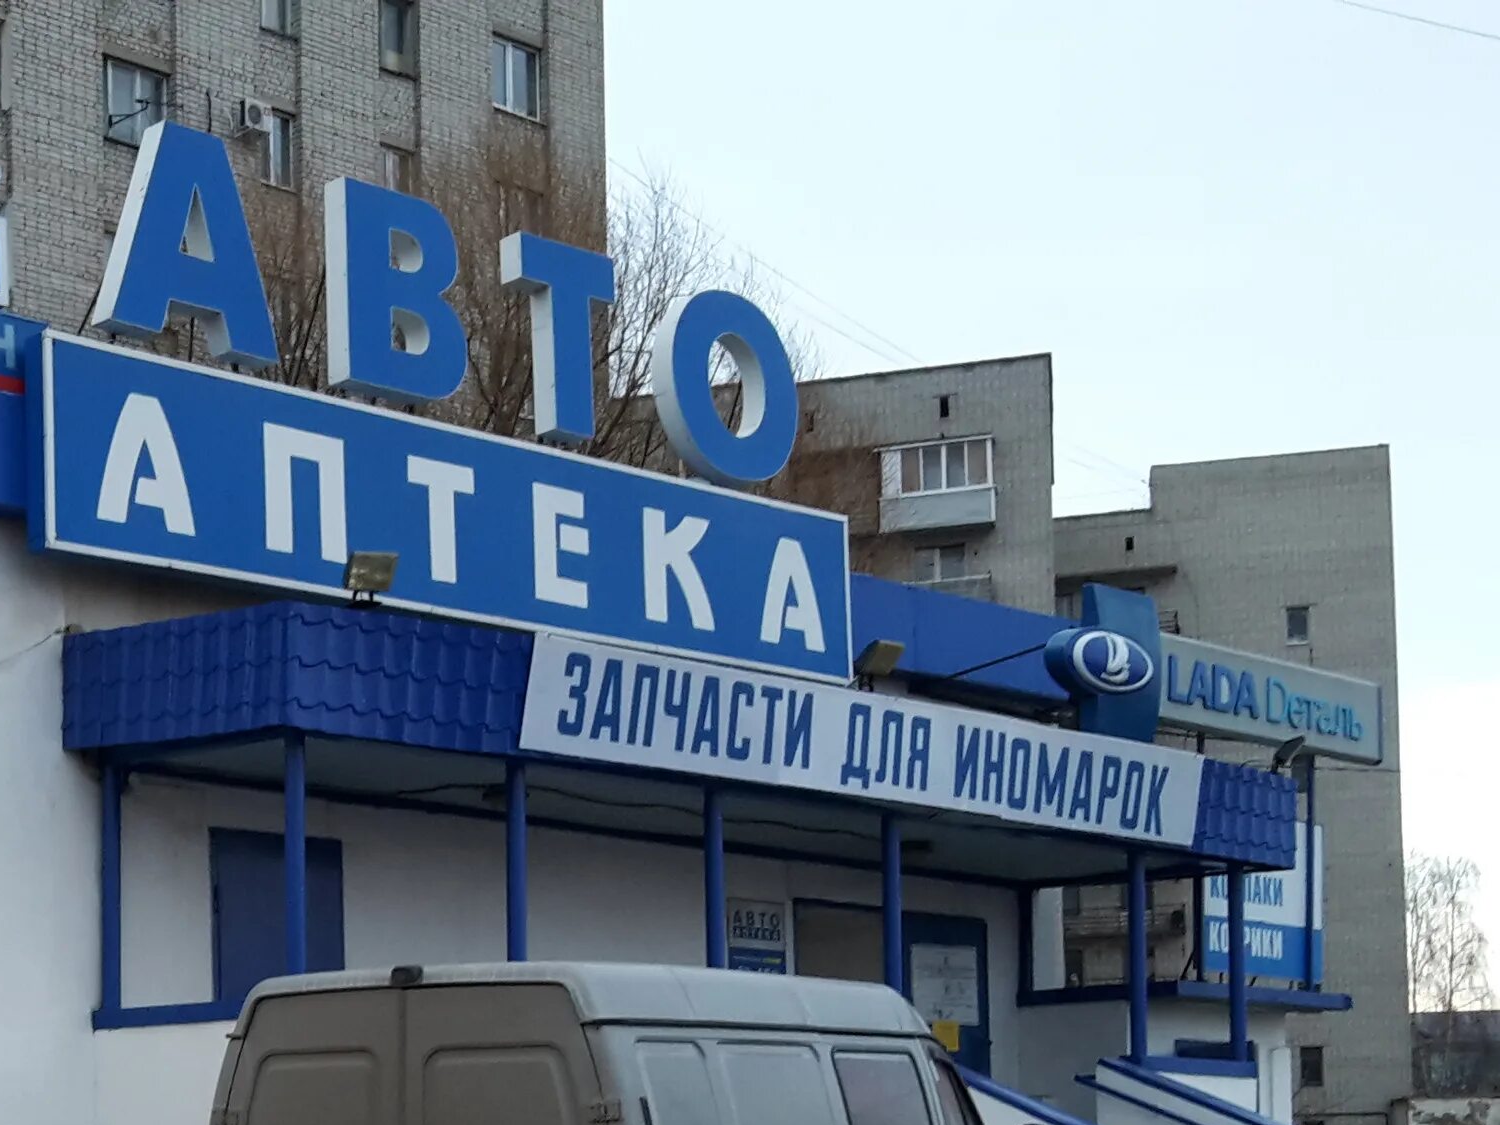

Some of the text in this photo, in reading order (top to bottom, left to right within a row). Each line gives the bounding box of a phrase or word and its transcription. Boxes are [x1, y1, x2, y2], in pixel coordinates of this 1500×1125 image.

[94, 120, 799, 483] АВТО
[96, 394, 825, 654] АПТЕКА
[557, 652, 1171, 837] ЗАПЧАСТИ ДЛЯ ИНОМАРОК
[1167, 655, 1259, 720] LADA
[1209, 921, 1283, 961] КОРИКИ
[1210, 874, 1283, 907] КОПАКИ
